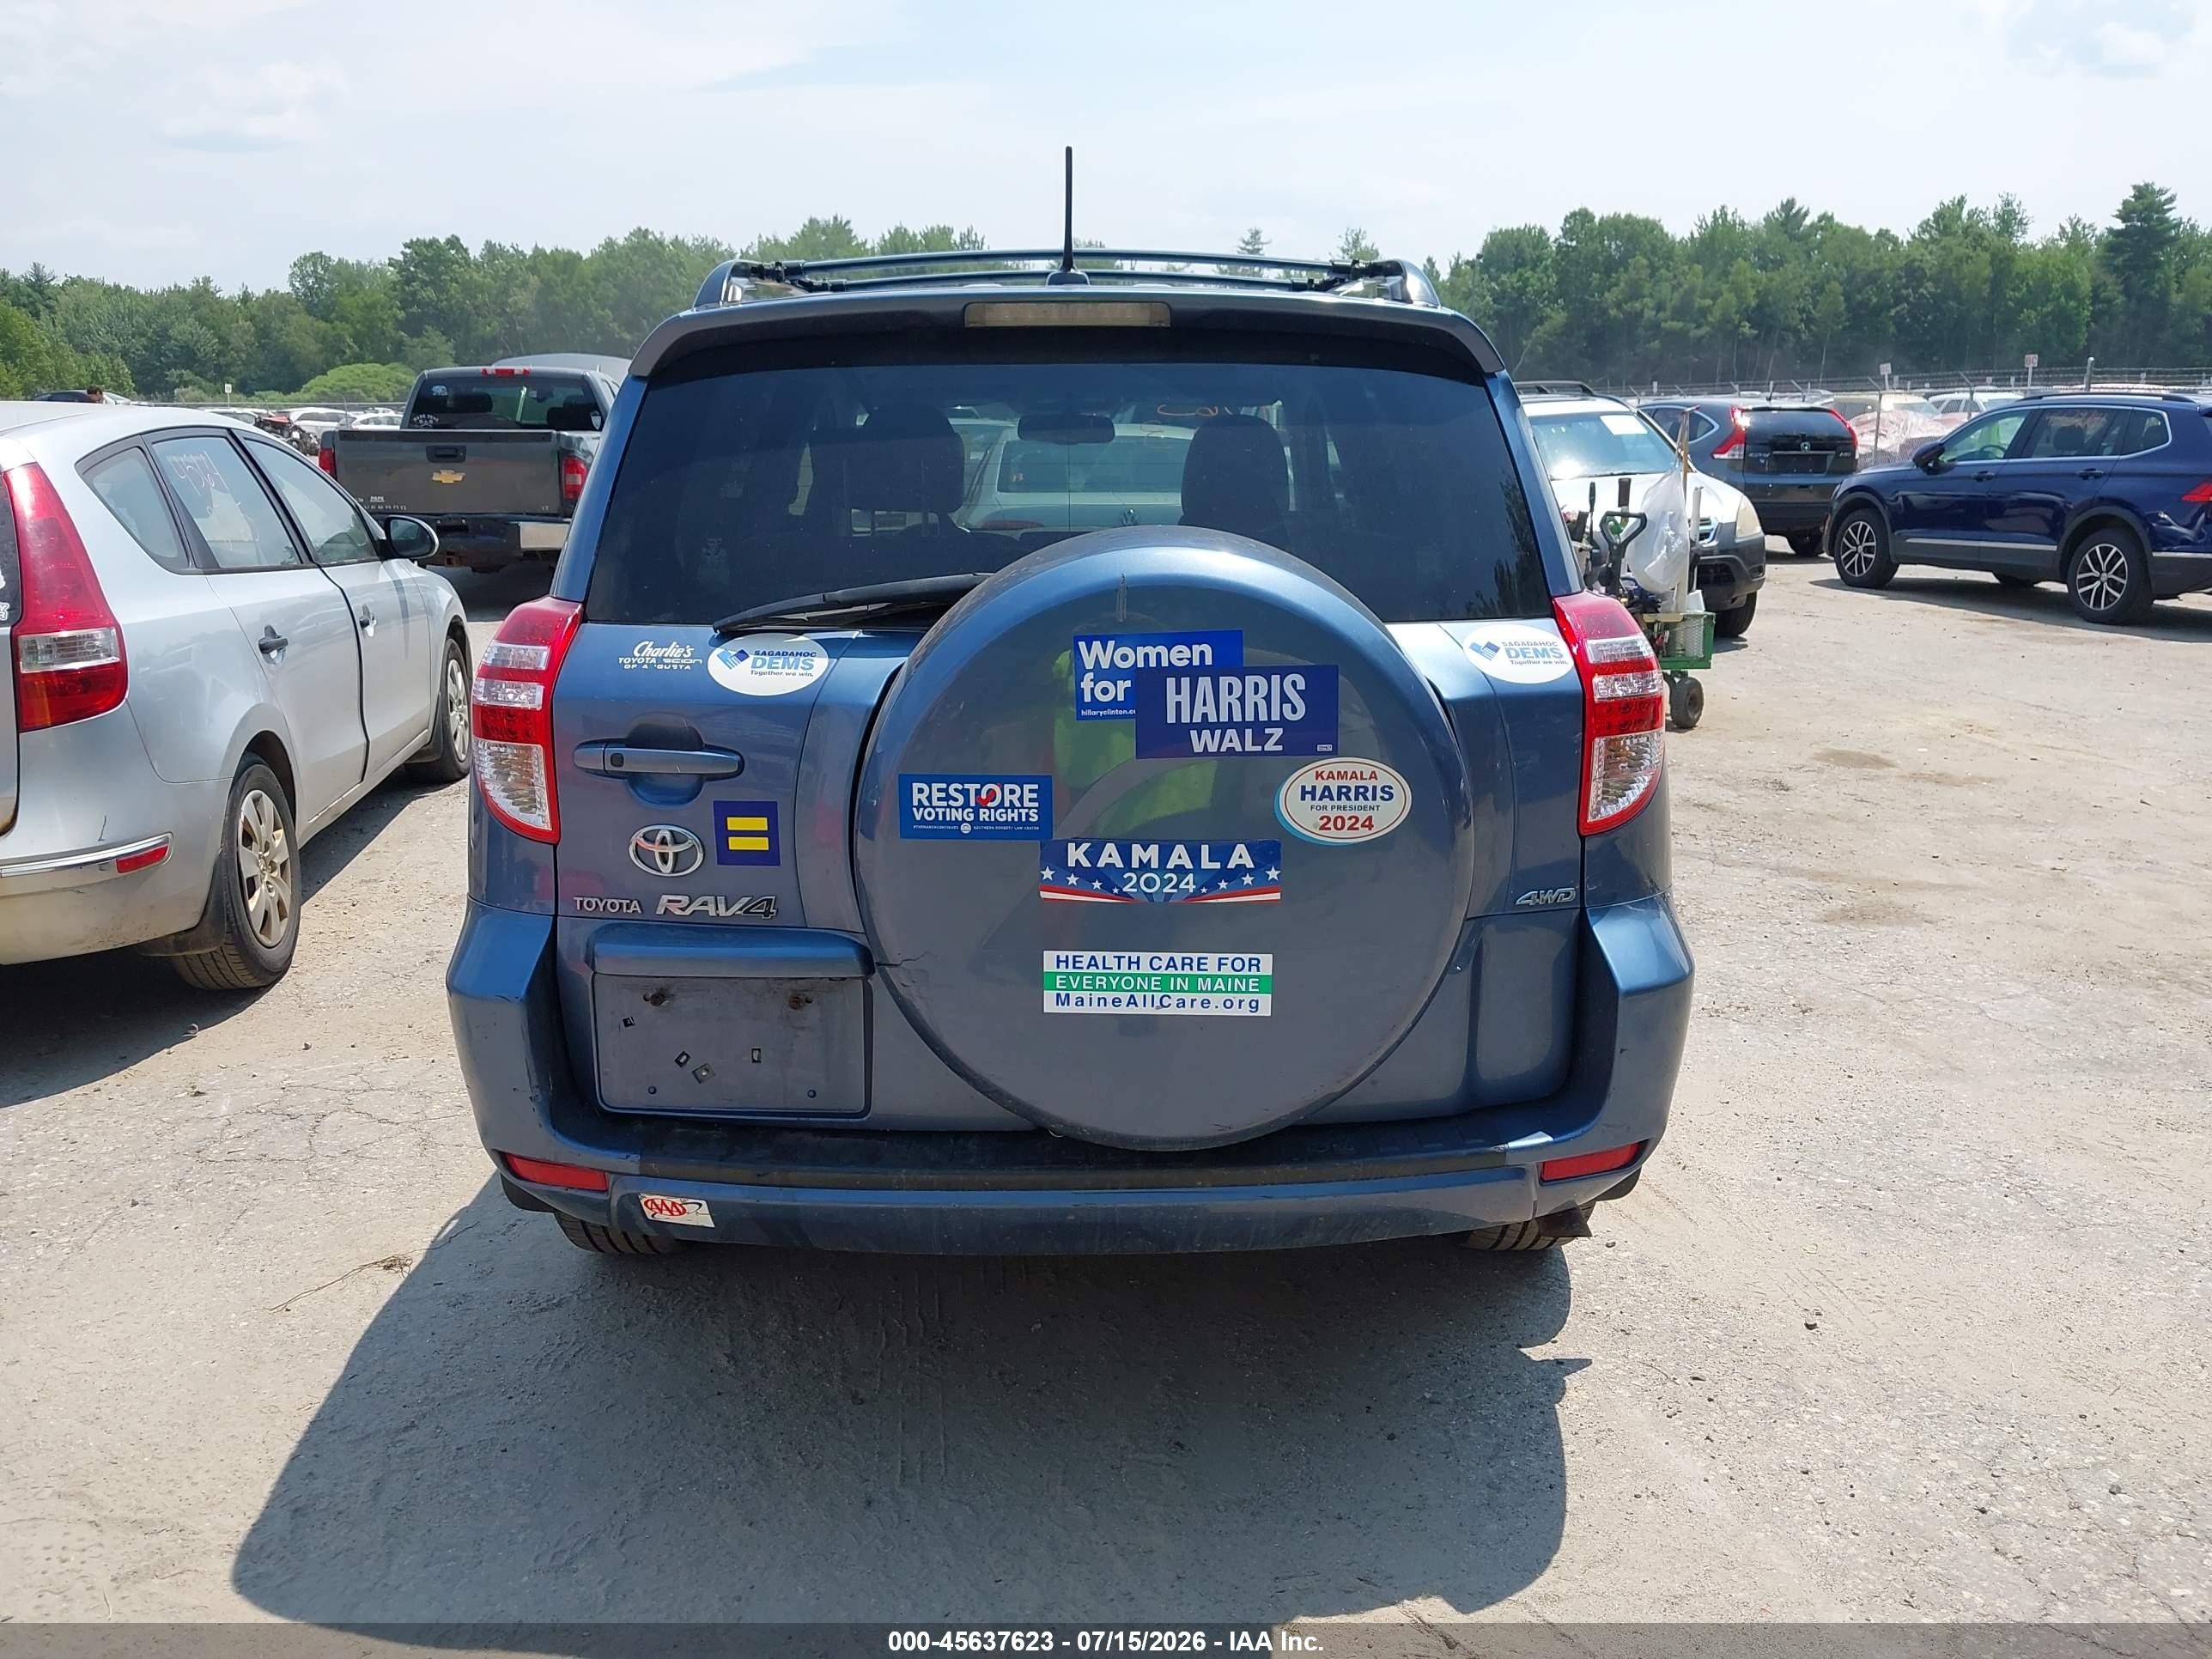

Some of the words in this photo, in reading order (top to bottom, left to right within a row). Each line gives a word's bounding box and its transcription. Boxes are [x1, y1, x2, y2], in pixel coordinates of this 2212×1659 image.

[633, 641, 695, 658] Charlie's
[1078, 640, 1212, 670] Women
[1504, 647, 1564, 659] DEMS
[750, 657, 815, 671] DEMS
[1080, 672, 1132, 702] for
[1166, 673, 1306, 724] HARRIS
[1080, 708, 1136, 717] hillaryclinton.c
[1189, 727, 1284, 753] WALZ
[1315, 770, 1378, 781] KAMALA
[912, 782, 1039, 808] RESTORE
[1300, 785, 1395, 802] HARRIS
[912, 807, 975, 822] VOTING
[979, 808, 1039, 822] RIGHTS
[1319, 815, 1374, 831] 2024
[1066, 842, 1255, 870] KAMALA
[1122, 872, 1195, 893] 2024
[573, 896, 642, 915] TOYOTA
[1515, 887, 1576, 906] 4WD
[655, 894, 777, 920] RAV4
[1055, 954, 1141, 971] HEALTH
[1149, 956, 1208, 972] CARE
[1217, 957, 1261, 973] FOR
[1055, 975, 1162, 991] EVERYONE
[1170, 976, 1188, 991] IN
[1197, 977, 1260, 992] MAINE
[1055, 993, 1261, 1013] MaineAllCare.org
[648, 1199, 684, 1216] AAA
